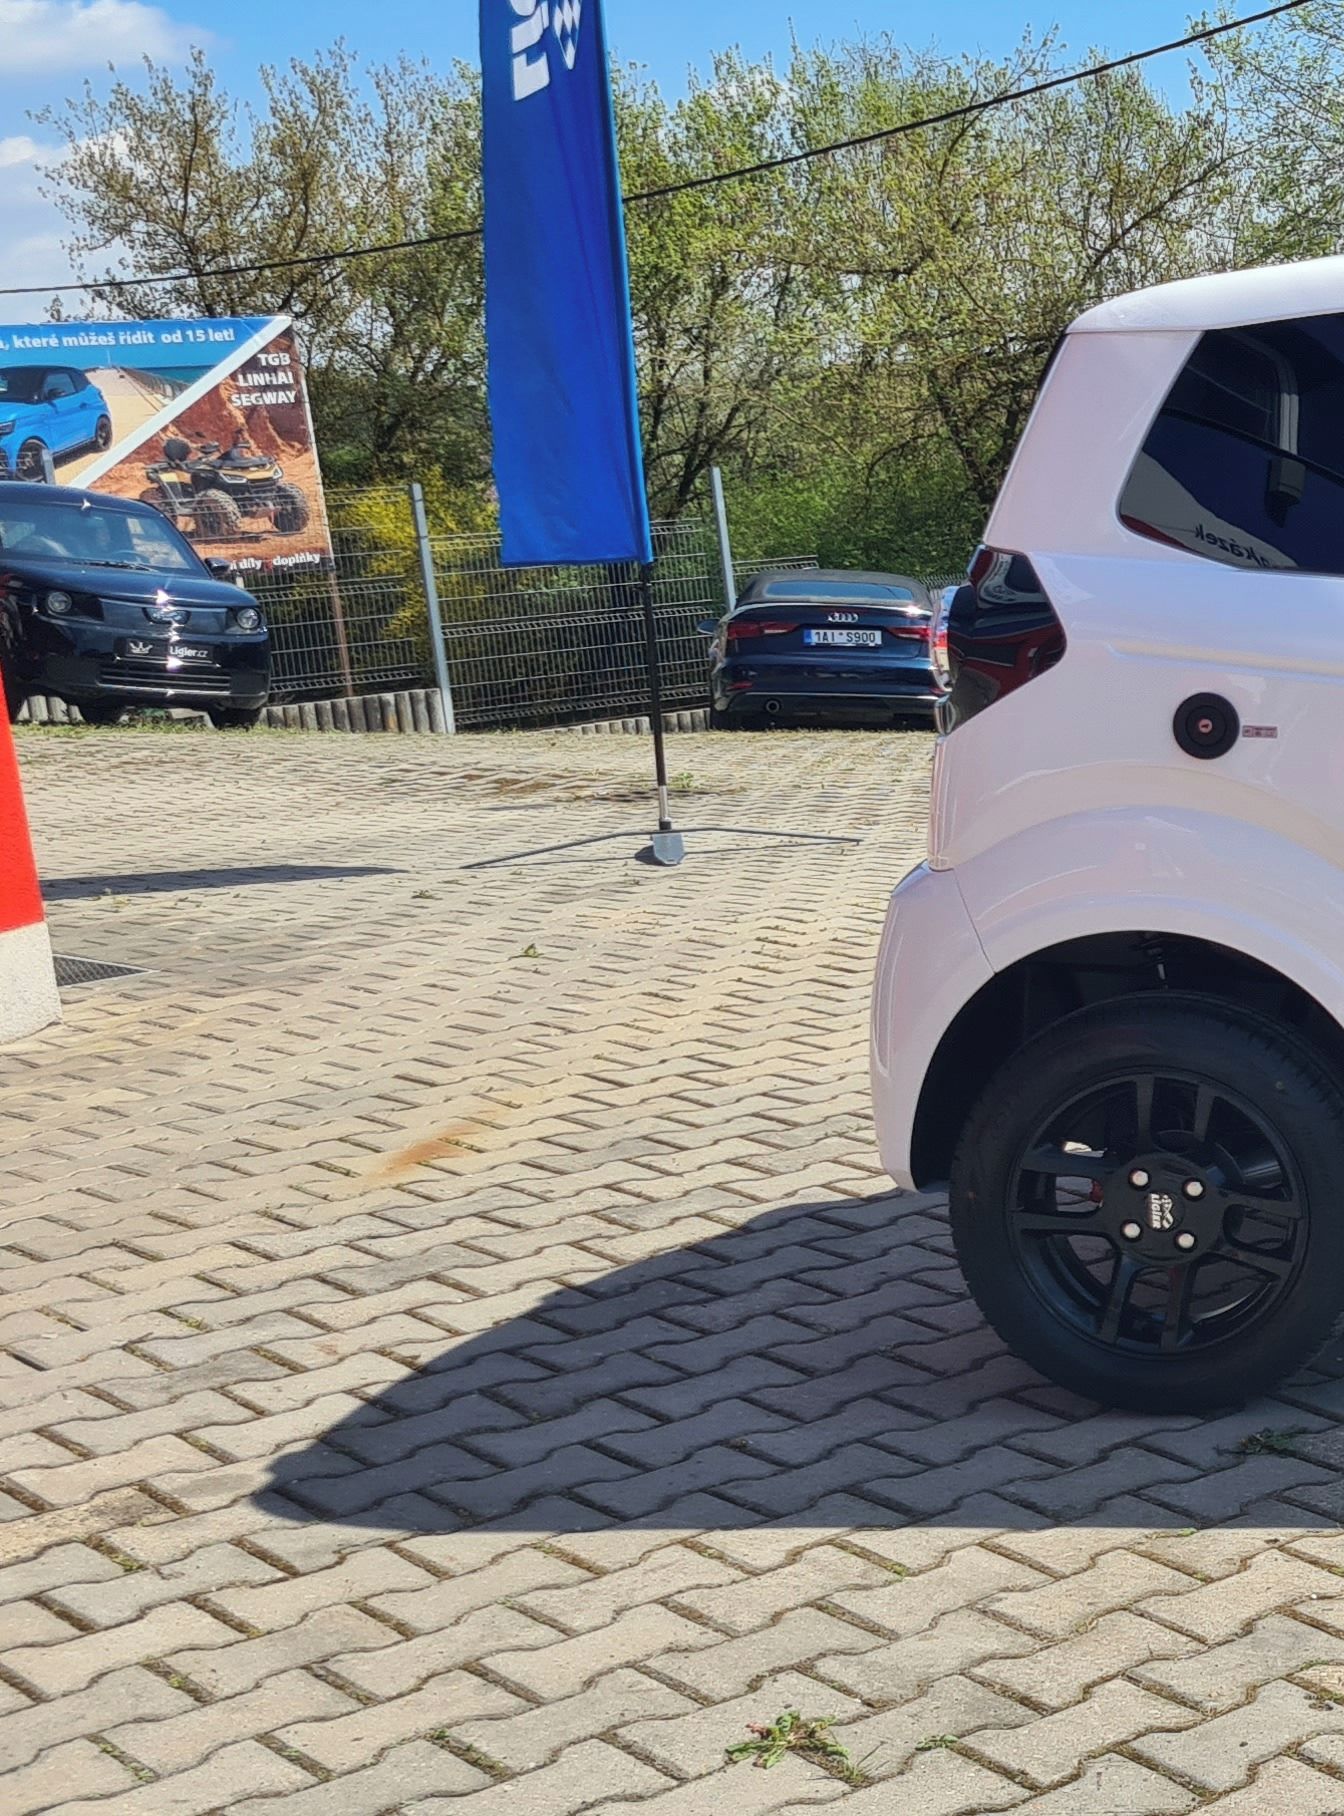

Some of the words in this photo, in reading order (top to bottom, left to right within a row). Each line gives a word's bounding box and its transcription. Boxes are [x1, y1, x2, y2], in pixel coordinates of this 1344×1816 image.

[12, 334, 60, 349] které
[62, 331, 116, 347] můžeš
[118, 330, 156, 345] řídit
[160, 329, 183, 344] od
[185, 329, 206, 342] 15
[207, 328, 235, 342] let!
[257, 352, 291, 366] TGB
[238, 371, 294, 387] LINHAI
[231, 390, 296, 407] SEGWAY
[846, 631, 876, 643] S900
